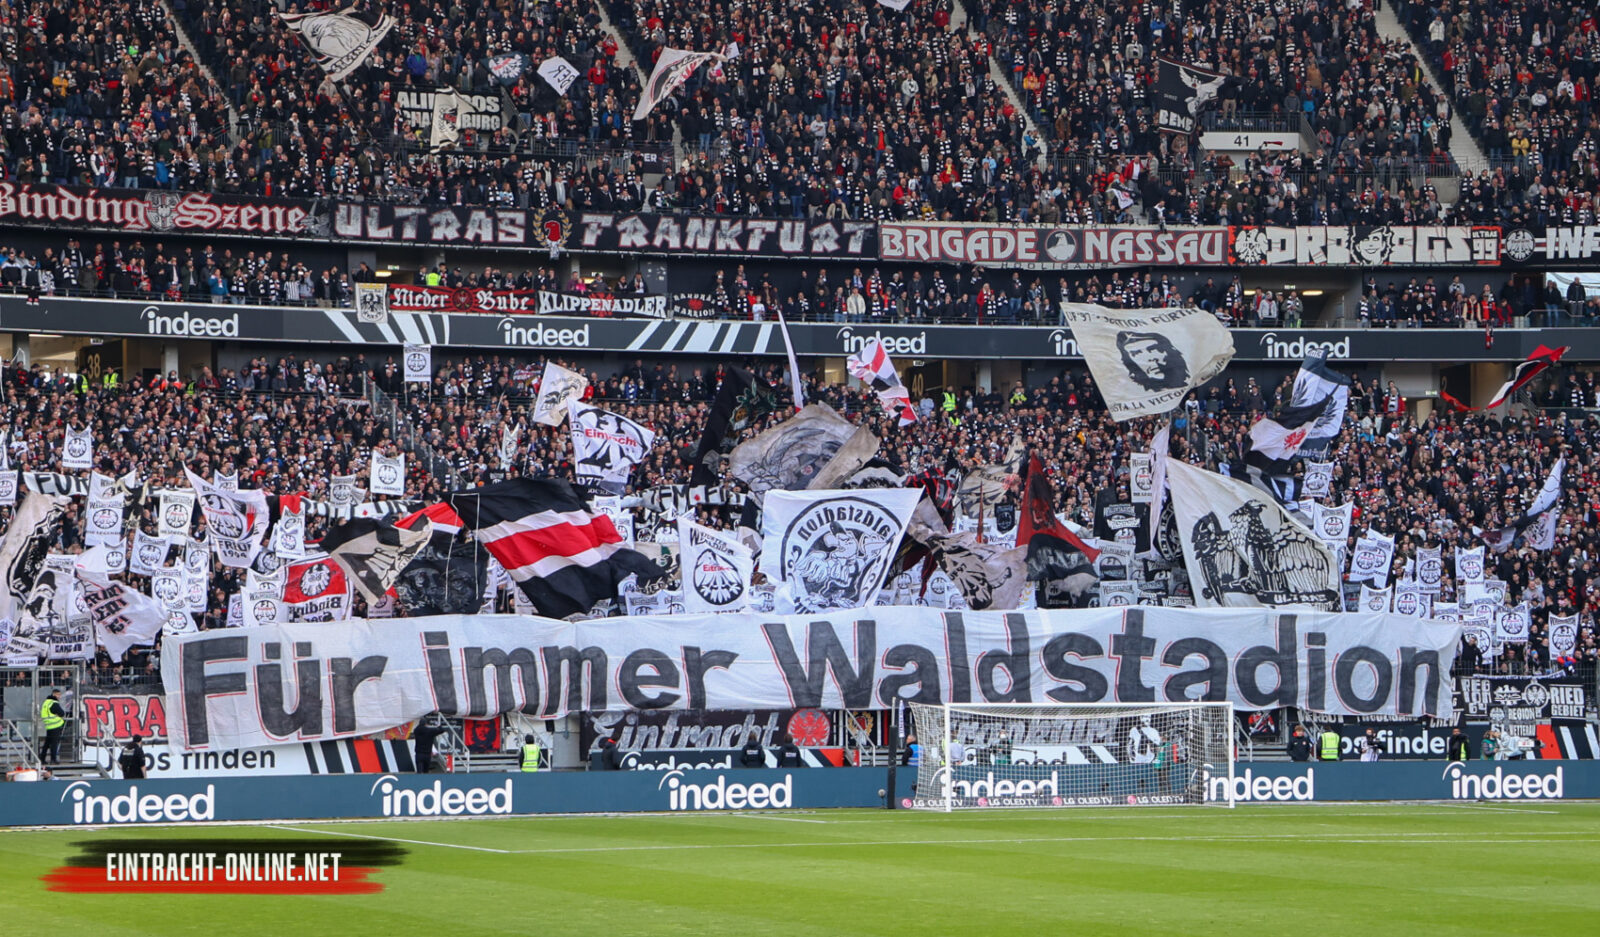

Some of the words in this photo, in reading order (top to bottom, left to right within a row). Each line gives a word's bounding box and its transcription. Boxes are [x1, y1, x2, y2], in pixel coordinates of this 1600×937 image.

[1233, 135, 1250, 148] 41
[0, 183, 150, 230] Binding
[175, 194, 307, 231] Szene
[334, 204, 527, 244] ULTRAS
[580, 213, 874, 253] FRANKFURT
[881, 227, 1039, 262] BRIGADE
[1084, 230, 1226, 264] NASSAU
[476, 290, 530, 311] Bube
[538, 290, 666, 318] KLIPPENADLER
[148, 311, 239, 337] indeed
[503, 321, 589, 347] indeed
[87, 353, 100, 379] 38
[911, 373, 924, 396] 40
[180, 636, 387, 748] Für
[420, 631, 739, 719] immer
[762, 608, 1439, 718] Waldstadion
[1551, 687, 1584, 704] RIED
[1509, 707, 1535, 720] REGION
[1551, 705, 1584, 717] GEBIET
[590, 711, 779, 750] Eintracht
[668, 774, 792, 810] indeed
[1203, 768, 1314, 801] indeed
[1452, 766, 1563, 799] indeed
[73, 784, 215, 824] indeed
[381, 778, 512, 816] indeed
[988, 798, 1000, 806] LG
[1063, 797, 1075, 805] LG
